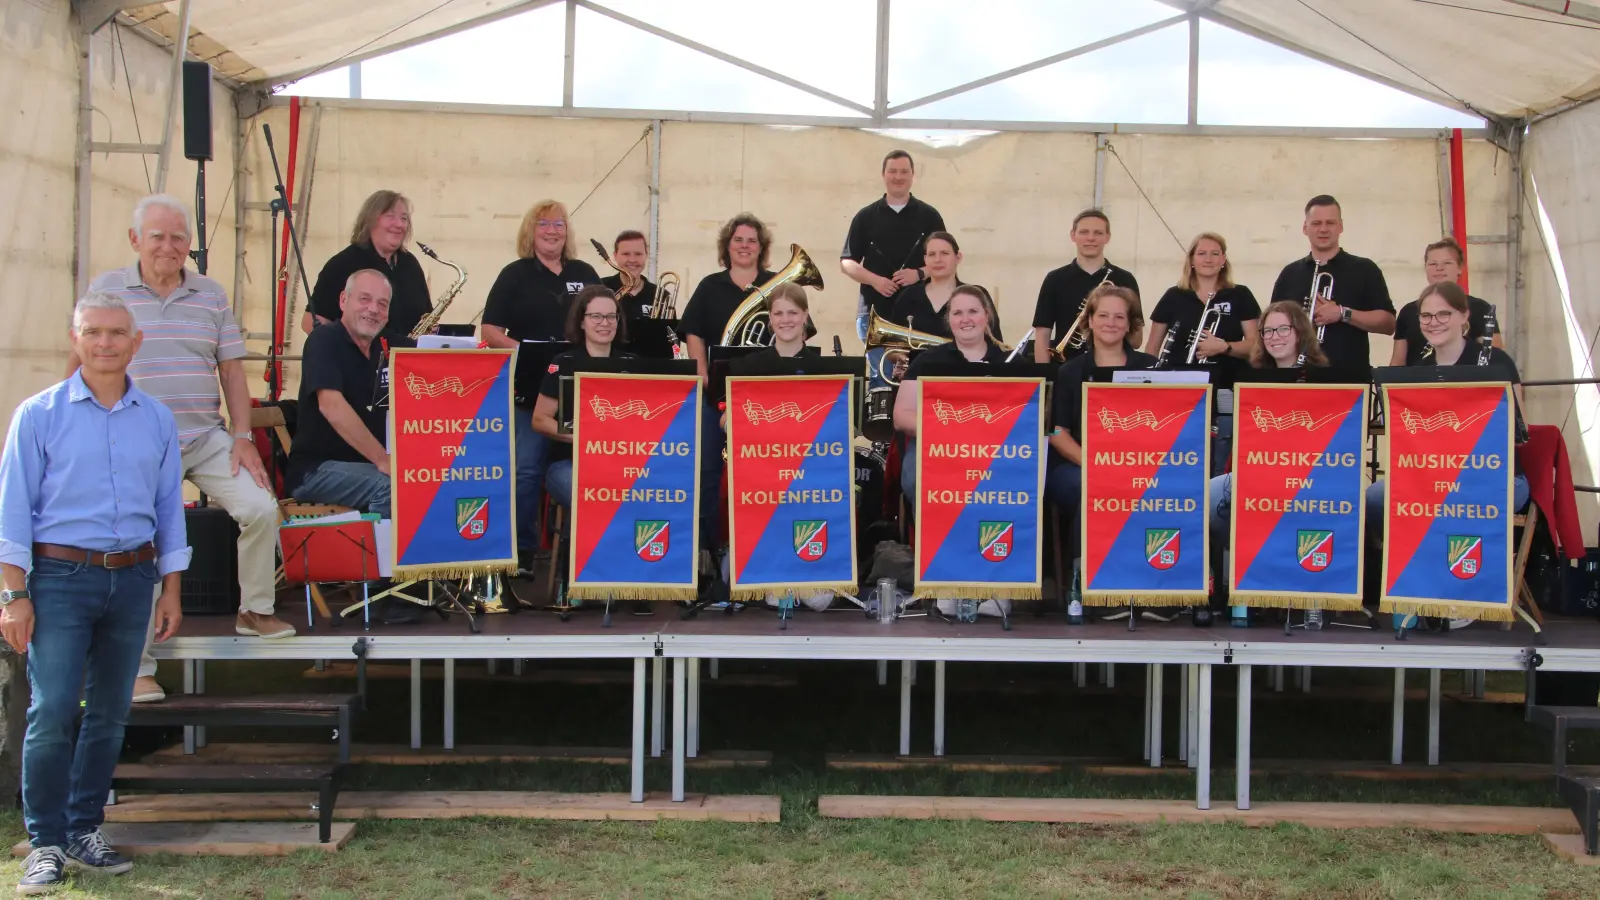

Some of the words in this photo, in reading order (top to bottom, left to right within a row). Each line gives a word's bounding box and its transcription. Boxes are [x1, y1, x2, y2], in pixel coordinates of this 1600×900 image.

[403, 417, 504, 434] MUSIKZUG
[441, 445, 467, 457] FFW
[585, 440, 690, 457] MUSIKZUG
[740, 441, 844, 459] MUSIKZUG
[928, 443, 1032, 459] MUSIKZUG
[1094, 451, 1199, 466] MUSIKZUG
[1246, 450, 1356, 467] MUSIKZUG
[1397, 453, 1501, 470] MUSIKZUG
[404, 466, 503, 483] KOLENFELD
[623, 467, 650, 479] FFW
[778, 469, 805, 481] FFW
[966, 469, 992, 481] FFW
[1132, 477, 1159, 489] FFW
[1285, 477, 1313, 489] FFW
[1434, 481, 1461, 493] FFW
[583, 486, 687, 503] KOLENFELD
[741, 489, 843, 505] KOLENFELD
[927, 489, 1029, 505] KOLENFELD
[1093, 498, 1197, 512] KOLENFELD
[1245, 497, 1353, 514] KOLENFELD
[1396, 502, 1499, 519] KOLENFELD
